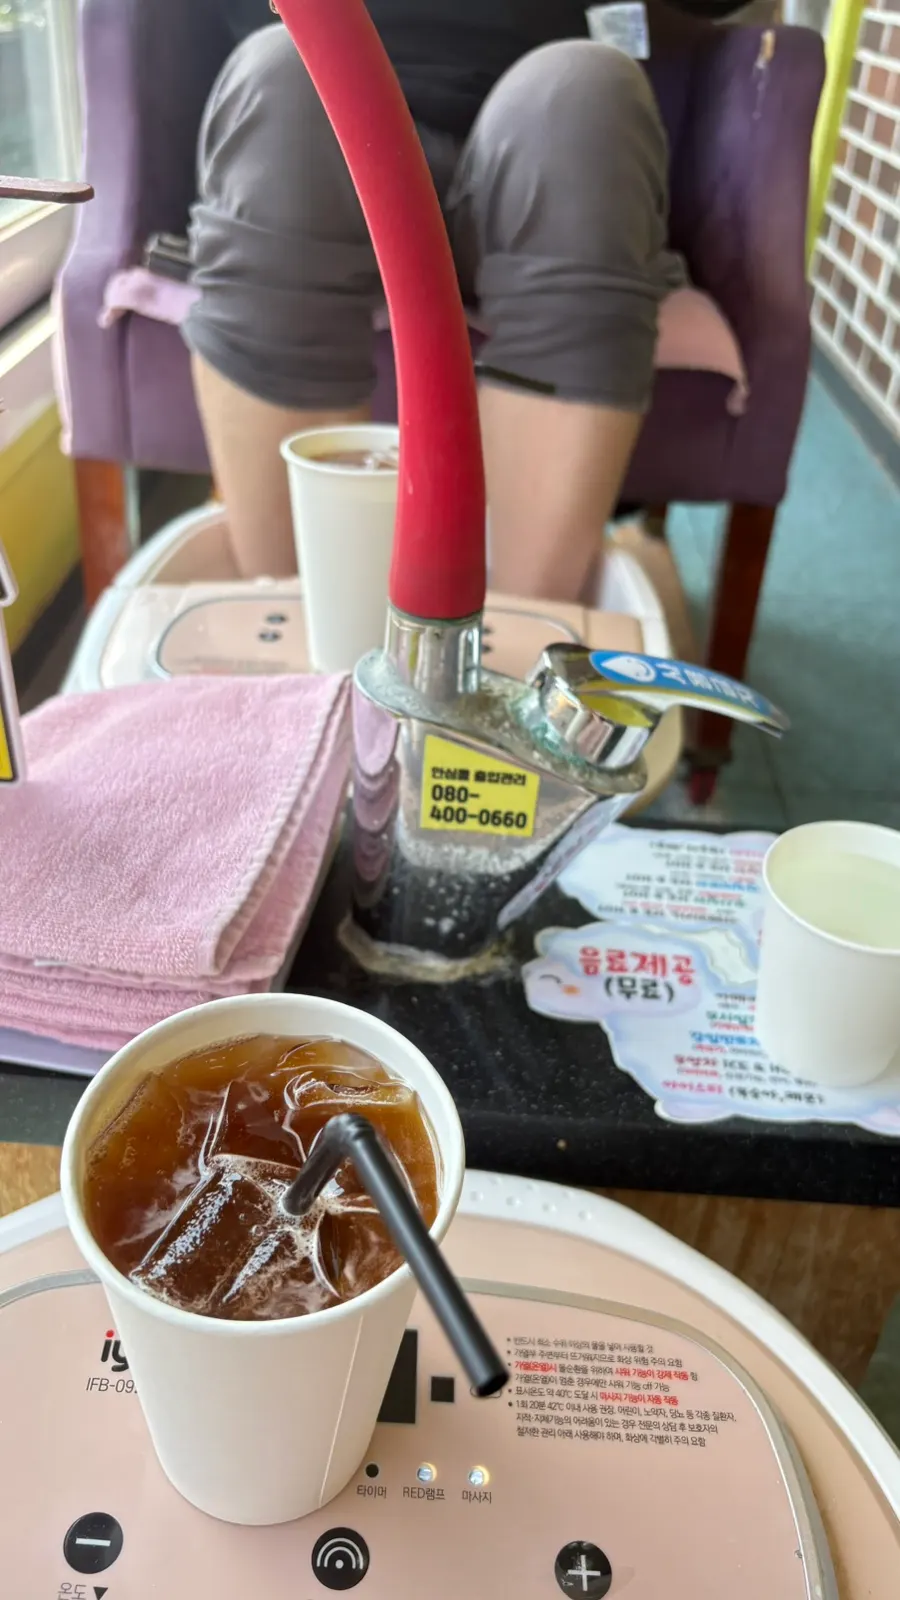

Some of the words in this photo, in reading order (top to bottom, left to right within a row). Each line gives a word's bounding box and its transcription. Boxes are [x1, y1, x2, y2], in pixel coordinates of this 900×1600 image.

[432, 767, 470, 781] 안심콜
[474, 770, 527, 786] 출입관리
[431, 784, 480, 803] 080-
[430, 805, 527, 829] 400-0660
[579, 946, 695, 986] 음료제공
[604, 976, 675, 1003] (무료)
[651, 1357, 666, 1366] 주의
[86, 1377, 138, 1394] IFB-09
[626, 1381, 641, 1390] 기능
[654, 1383, 670, 1392] 가능
[574, 1390, 588, 1400] 도달
[590, 1391, 598, 1400] 시
[624, 1393, 645, 1403] 기능이
[516, 1400, 528, 1408] 1회
[529, 1400, 546, 1410] 20분
[566, 1403, 581, 1412] 이내
[582, 1404, 597, 1414] 사용
[670, 1408, 685, 1418] 당뇨
[686, 1410, 694, 1419] 등
[695, 1410, 710, 1421] 각종
[573, 1416, 603, 1427] 어려움이
[604, 1418, 620, 1428] 있는
[622, 1419, 636, 1429] 경우
[638, 1420, 660, 1430] 전문의
[662, 1421, 677, 1432] 상담
[679, 1422, 687, 1432] 후
[688, 1423, 718, 1434] 보호자의
[517, 1426, 540, 1437] 철저한
[541, 1427, 556, 1438] 관리
[557, 1429, 573, 1439] 아래
[575, 1430, 604, 1440] 사용해야
[625, 1432, 648, 1443] 화상에
[650, 1434, 672, 1444] 각별히
[674, 1435, 689, 1445] 주의
[690, 1436, 706, 1447] 요함
[357, 1485, 387, 1498] 타이머
[402, 1486, 445, 1501] RED램프
[462, 1490, 493, 1504] 마사지
[58, 1582, 87, 1600] 온도
